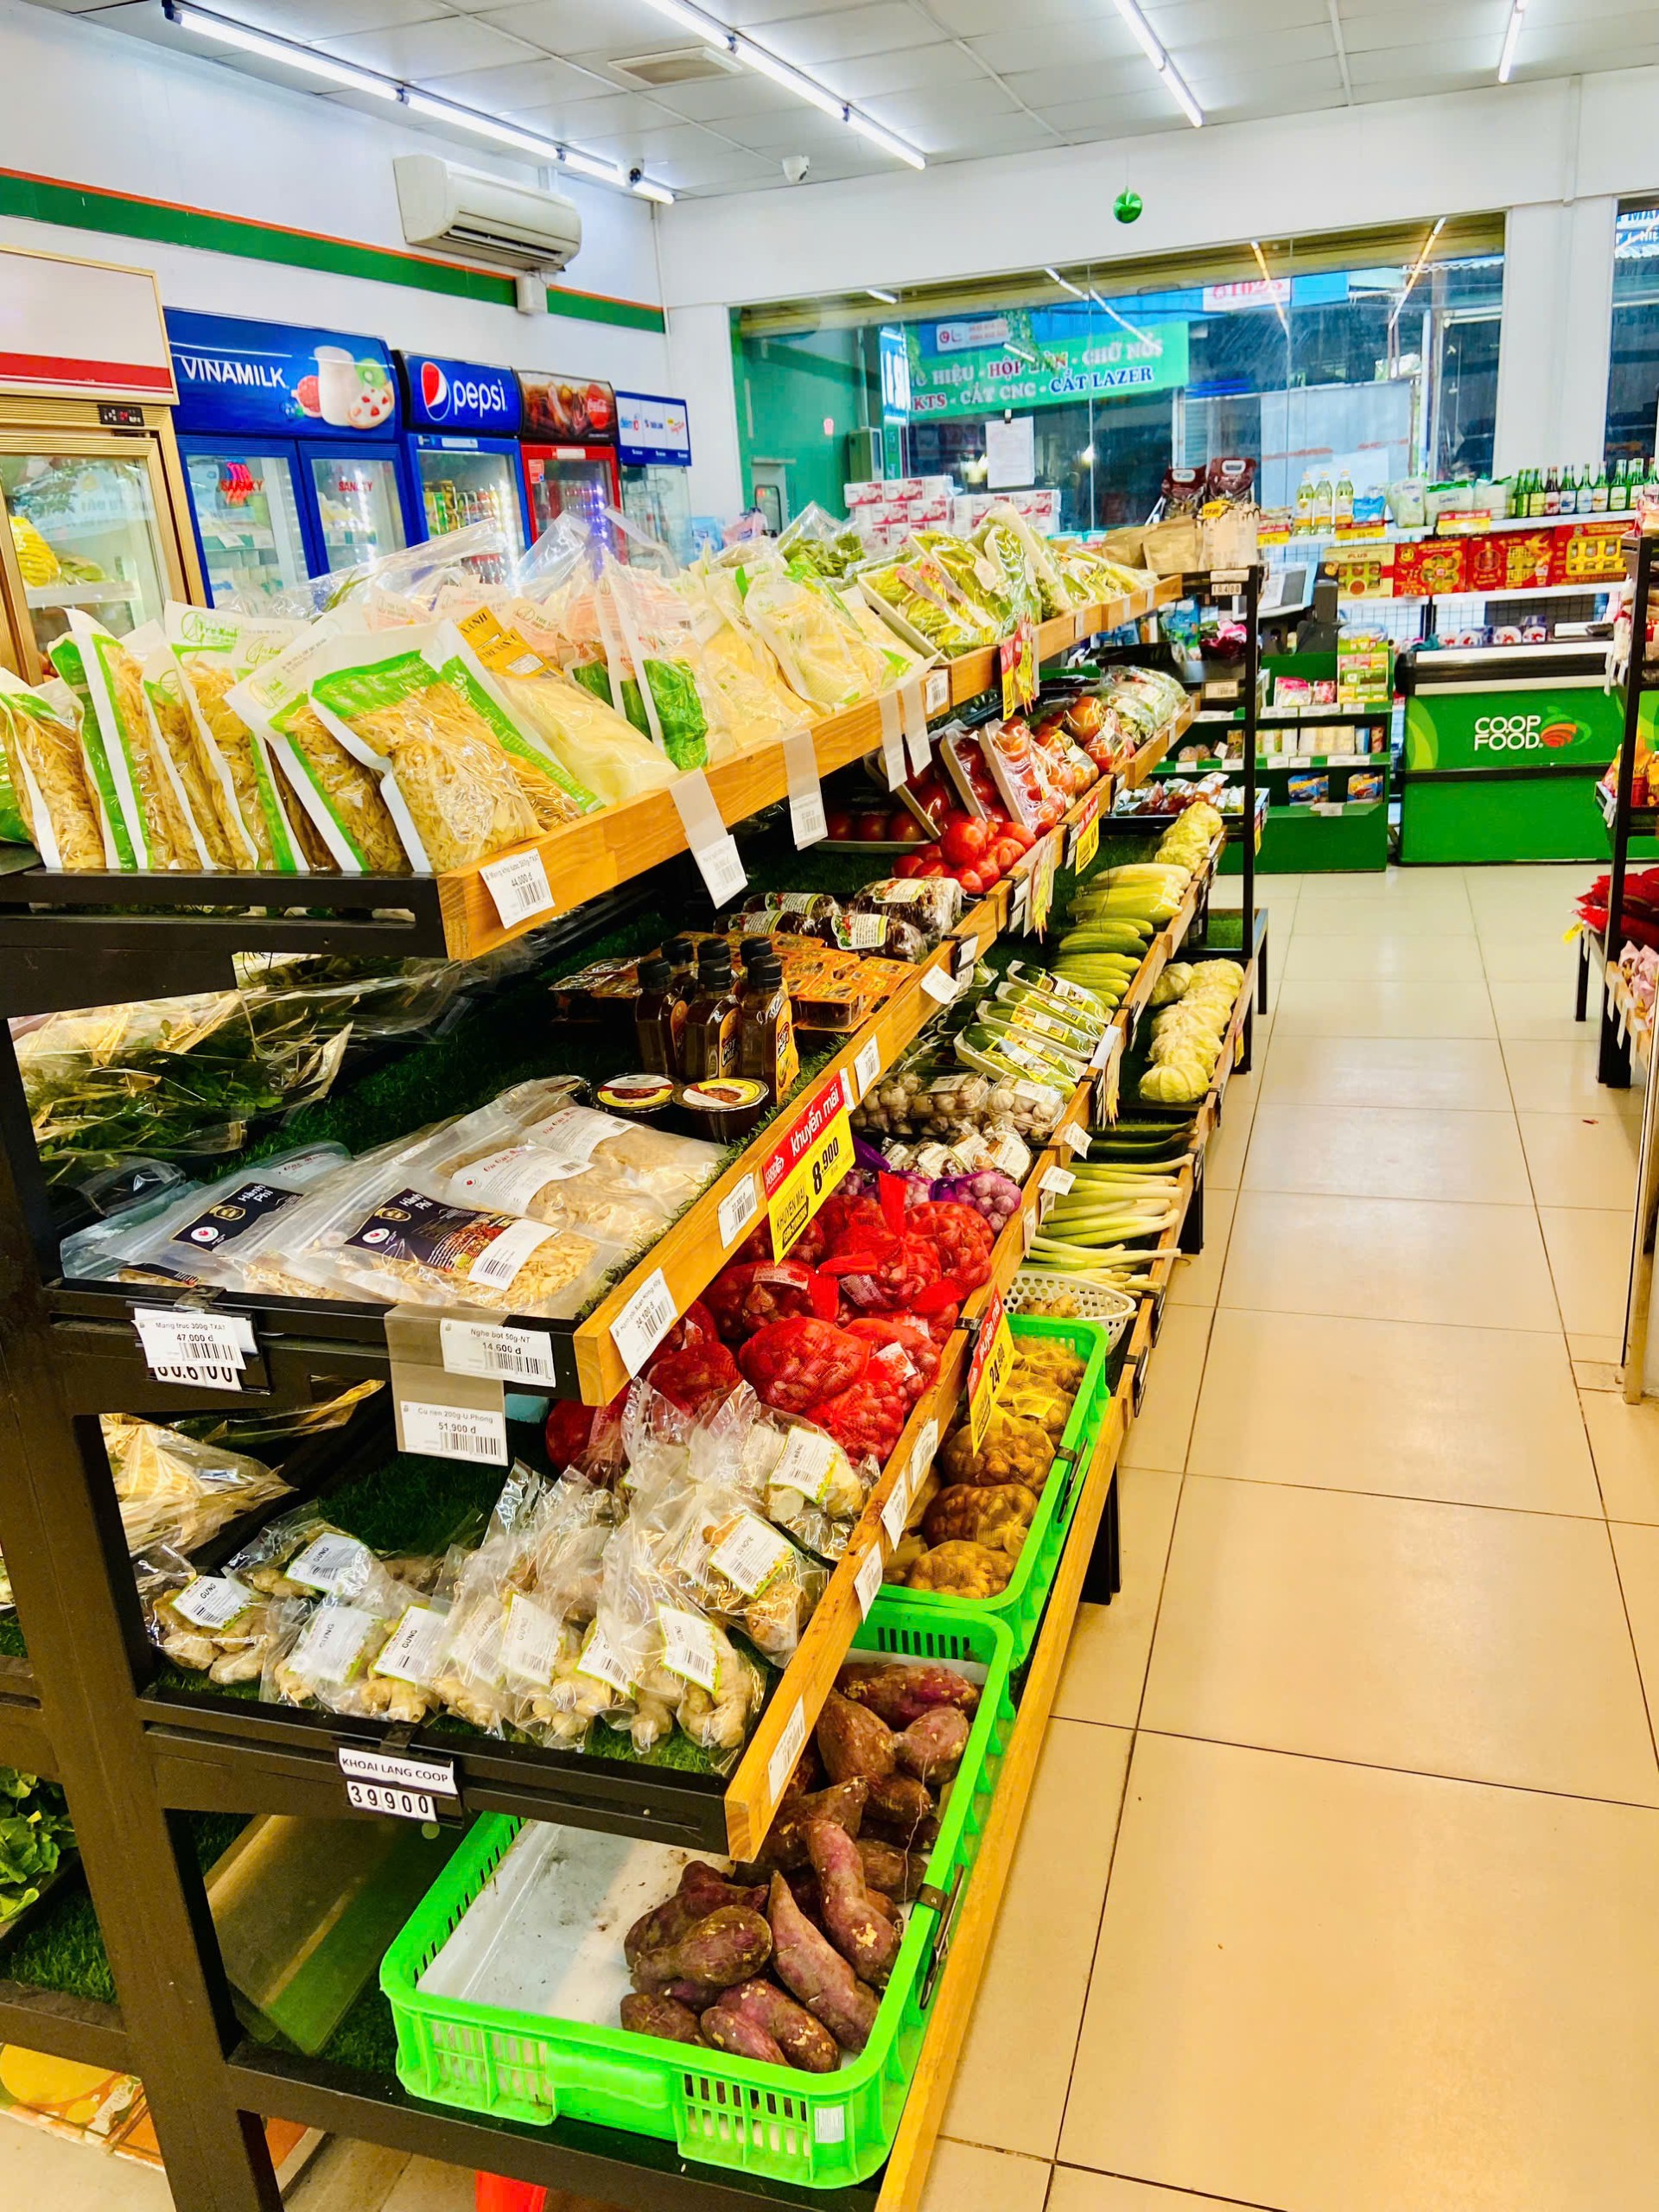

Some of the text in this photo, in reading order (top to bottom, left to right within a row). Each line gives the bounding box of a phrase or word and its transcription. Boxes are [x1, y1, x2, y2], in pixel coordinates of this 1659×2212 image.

[180, 356, 286, 389] VINAMILK
[453, 378, 505, 417] pepsi
[913, 393, 947, 411] KTS
[999, 383, 1036, 400] CNC
[1092, 366, 1154, 388] LAZER
[1474, 732, 1540, 751] FOOD
[790, 1083, 840, 1157] khuyến mãi
[238, 1185, 266, 1202] Hành
[399, 1193, 423, 1207] Hành
[342, 1758, 448, 1782] KHOAI LANG COOP
